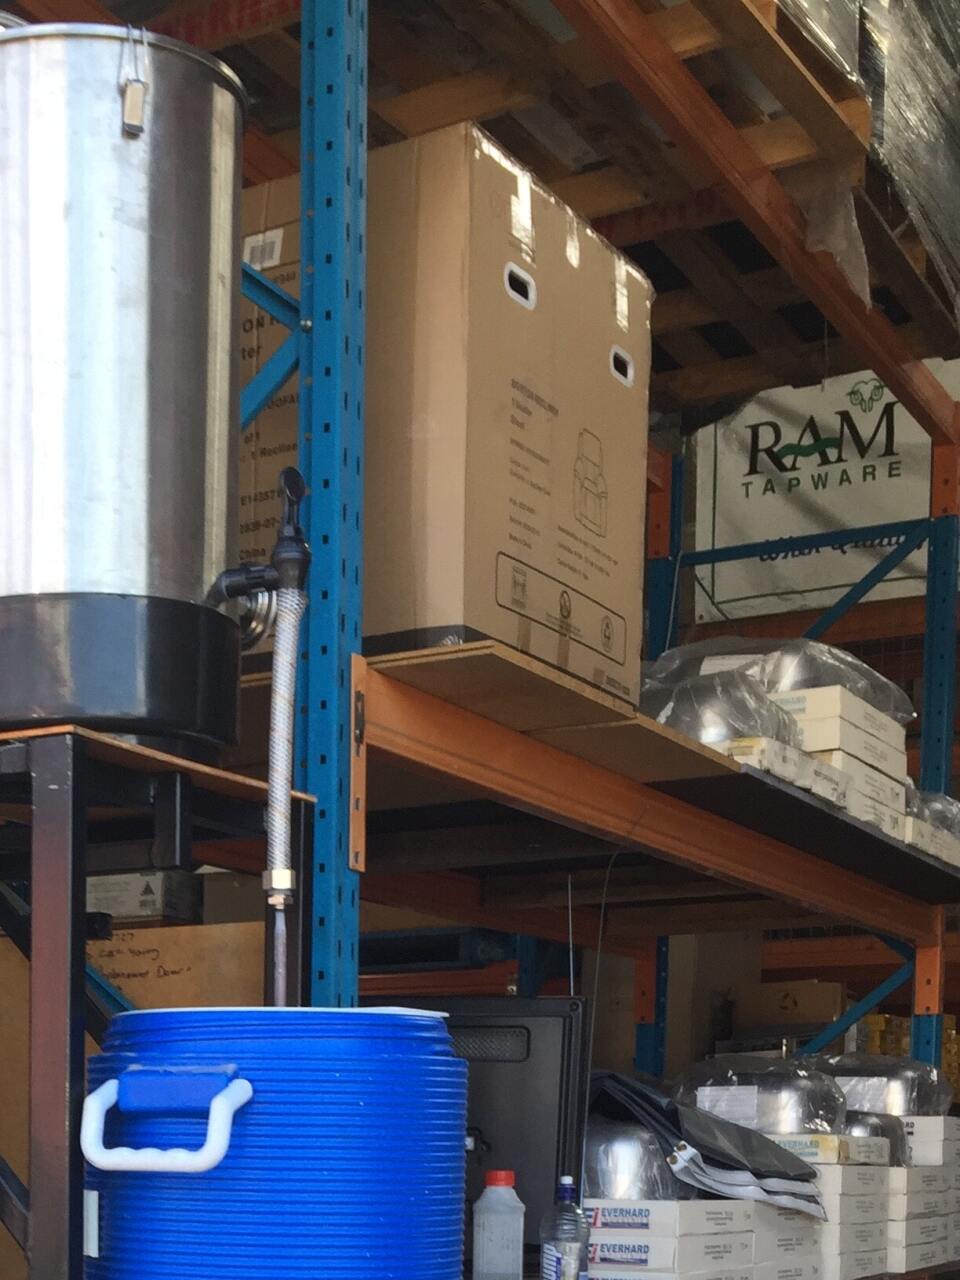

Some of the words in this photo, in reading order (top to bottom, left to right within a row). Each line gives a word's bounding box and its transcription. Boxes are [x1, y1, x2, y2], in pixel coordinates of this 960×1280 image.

[743, 400, 900, 478] RAM
[742, 461, 902, 499] TAPWARE
[602, 1208, 650, 1219] EVERHARD
[600, 1244, 649, 1254] EVERHARD
